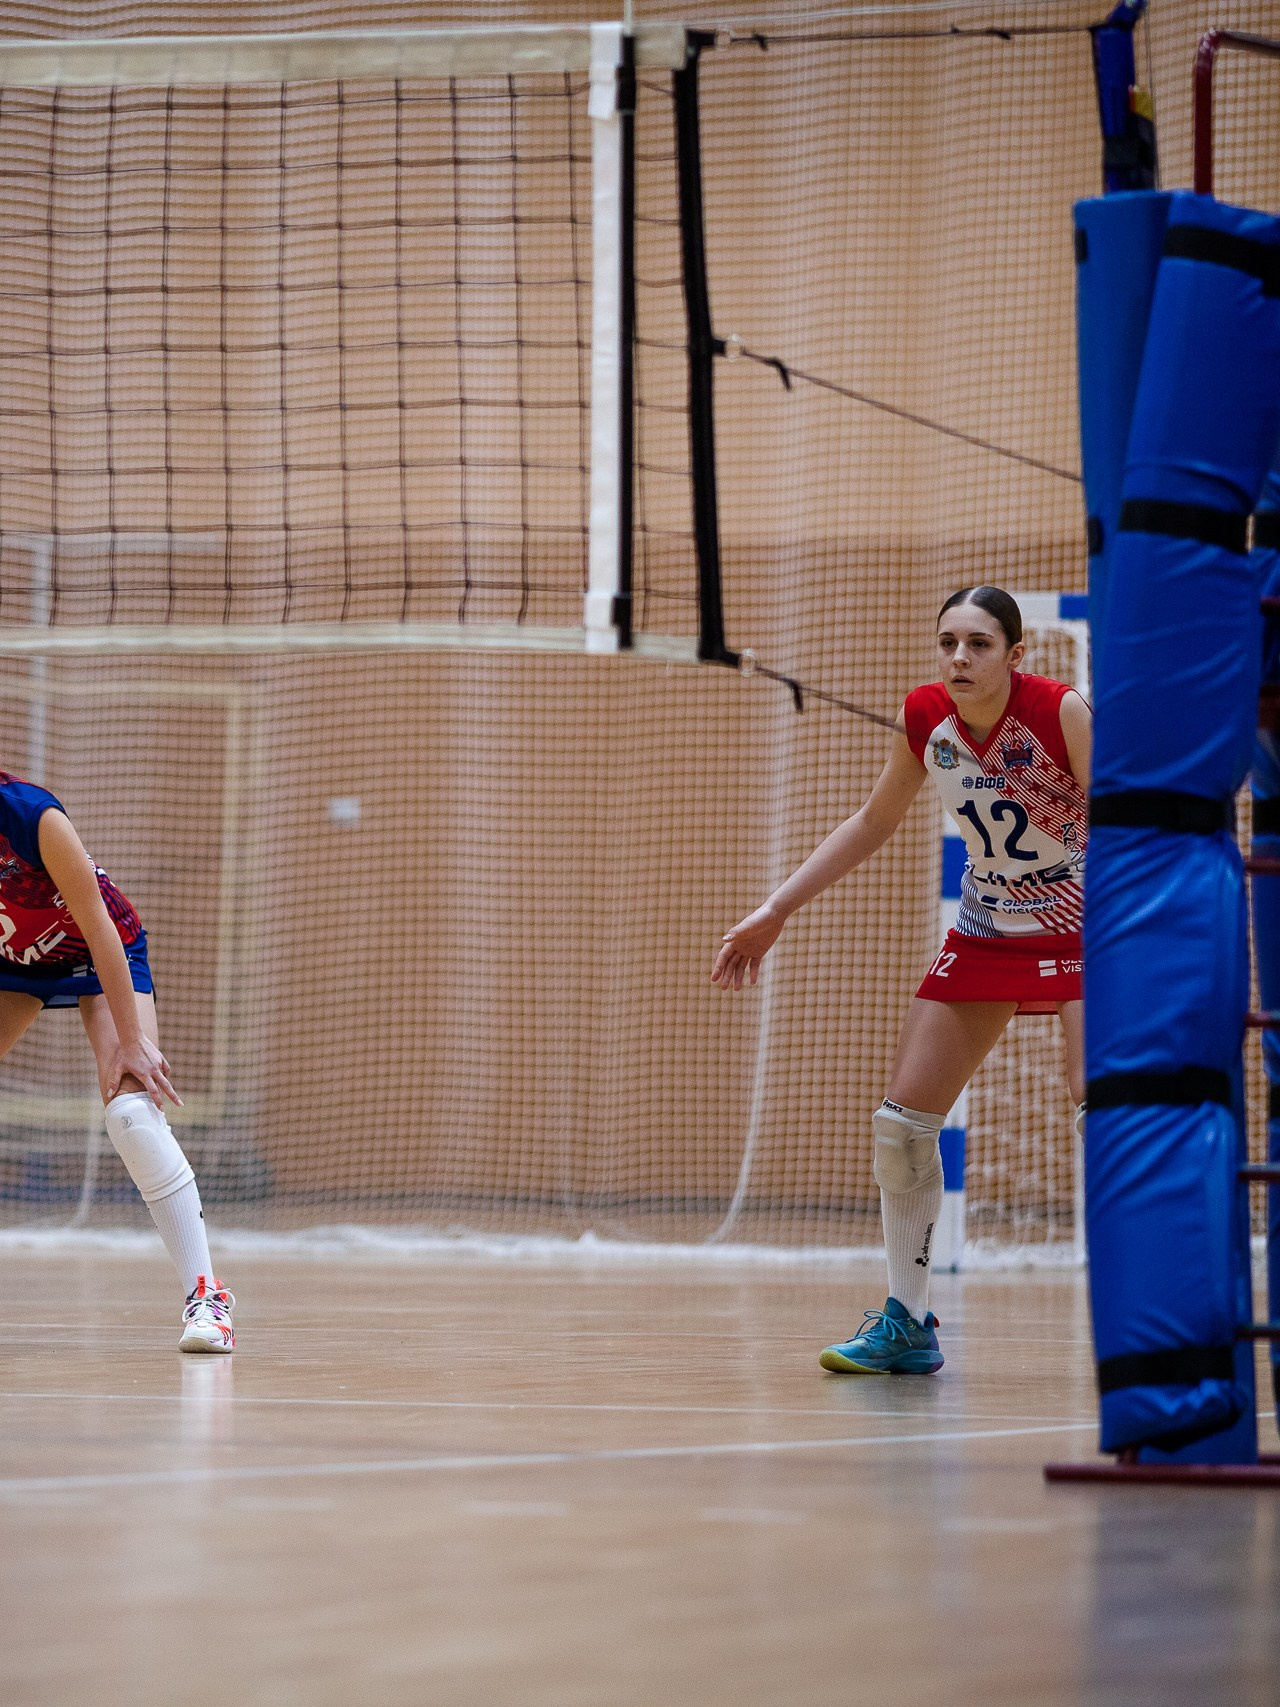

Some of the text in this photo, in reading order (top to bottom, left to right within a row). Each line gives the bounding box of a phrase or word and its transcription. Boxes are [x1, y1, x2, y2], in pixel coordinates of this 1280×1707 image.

[975, 777, 1006, 789] ВФВ
[956, 800, 1039, 861] 12
[1002, 895, 1062, 907] GLOBAL
[1003, 905, 1055, 915] VISION
[930, 950, 958, 978] 12
[1062, 965, 1085, 974] VIS
